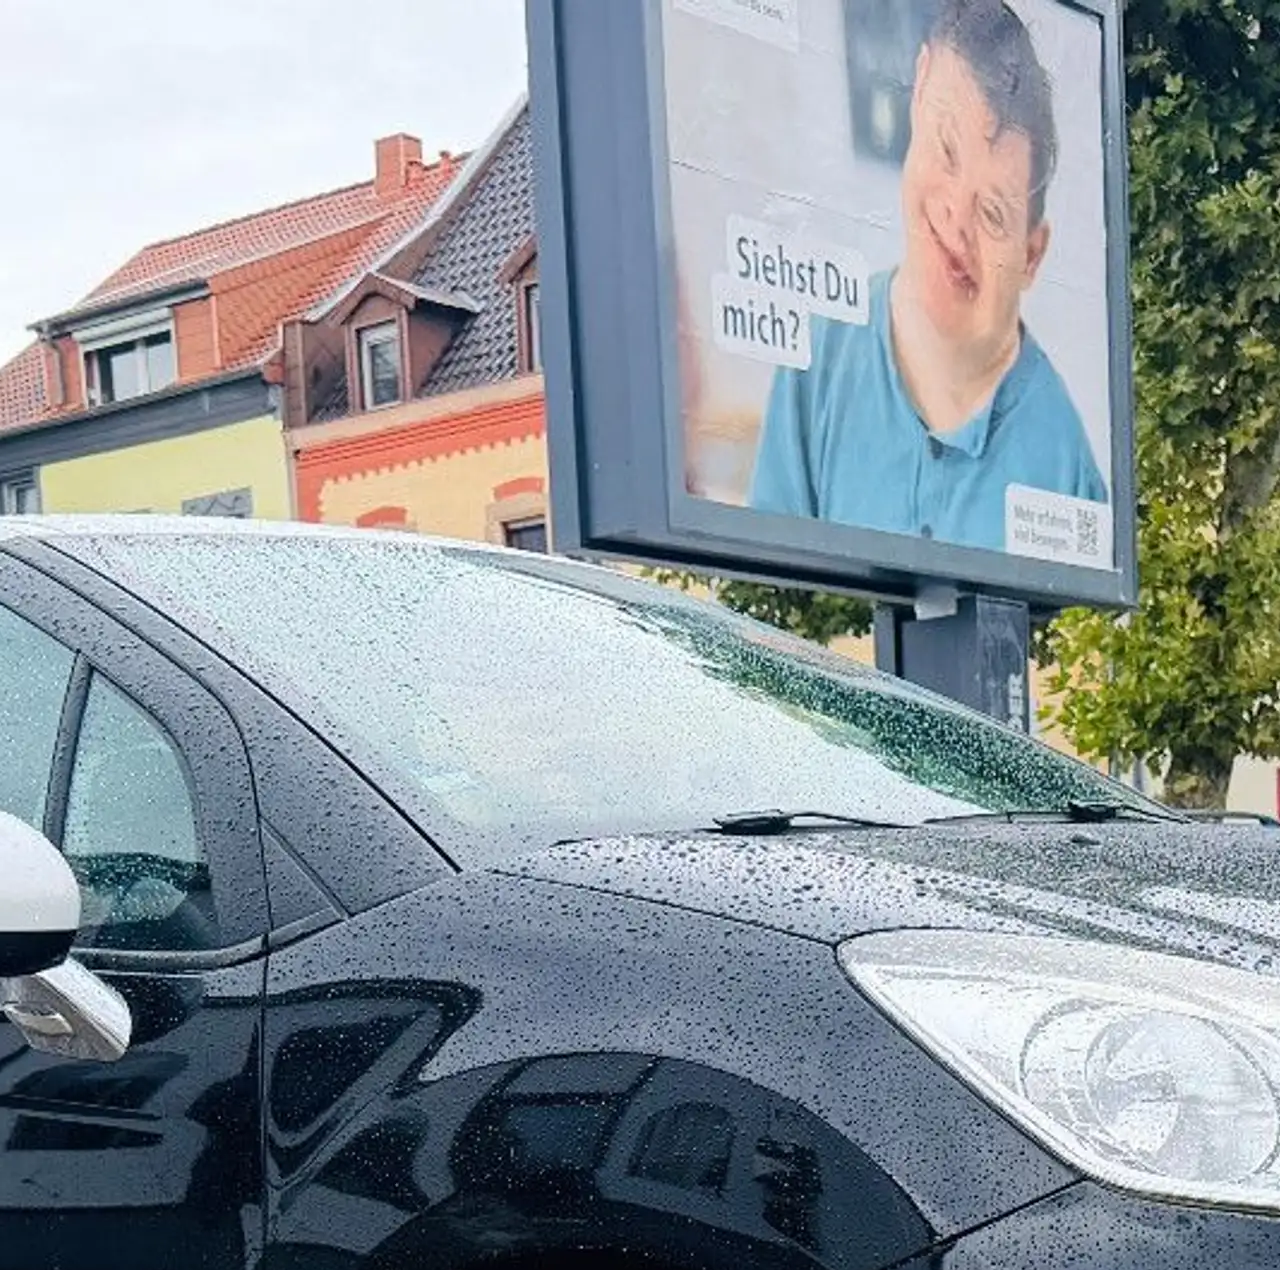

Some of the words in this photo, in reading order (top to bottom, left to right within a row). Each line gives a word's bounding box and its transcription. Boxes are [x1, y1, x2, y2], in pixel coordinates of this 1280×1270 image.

[736, 236, 817, 297] Siehst
[824, 261, 858, 307] Du
[723, 299, 800, 351] mich?
